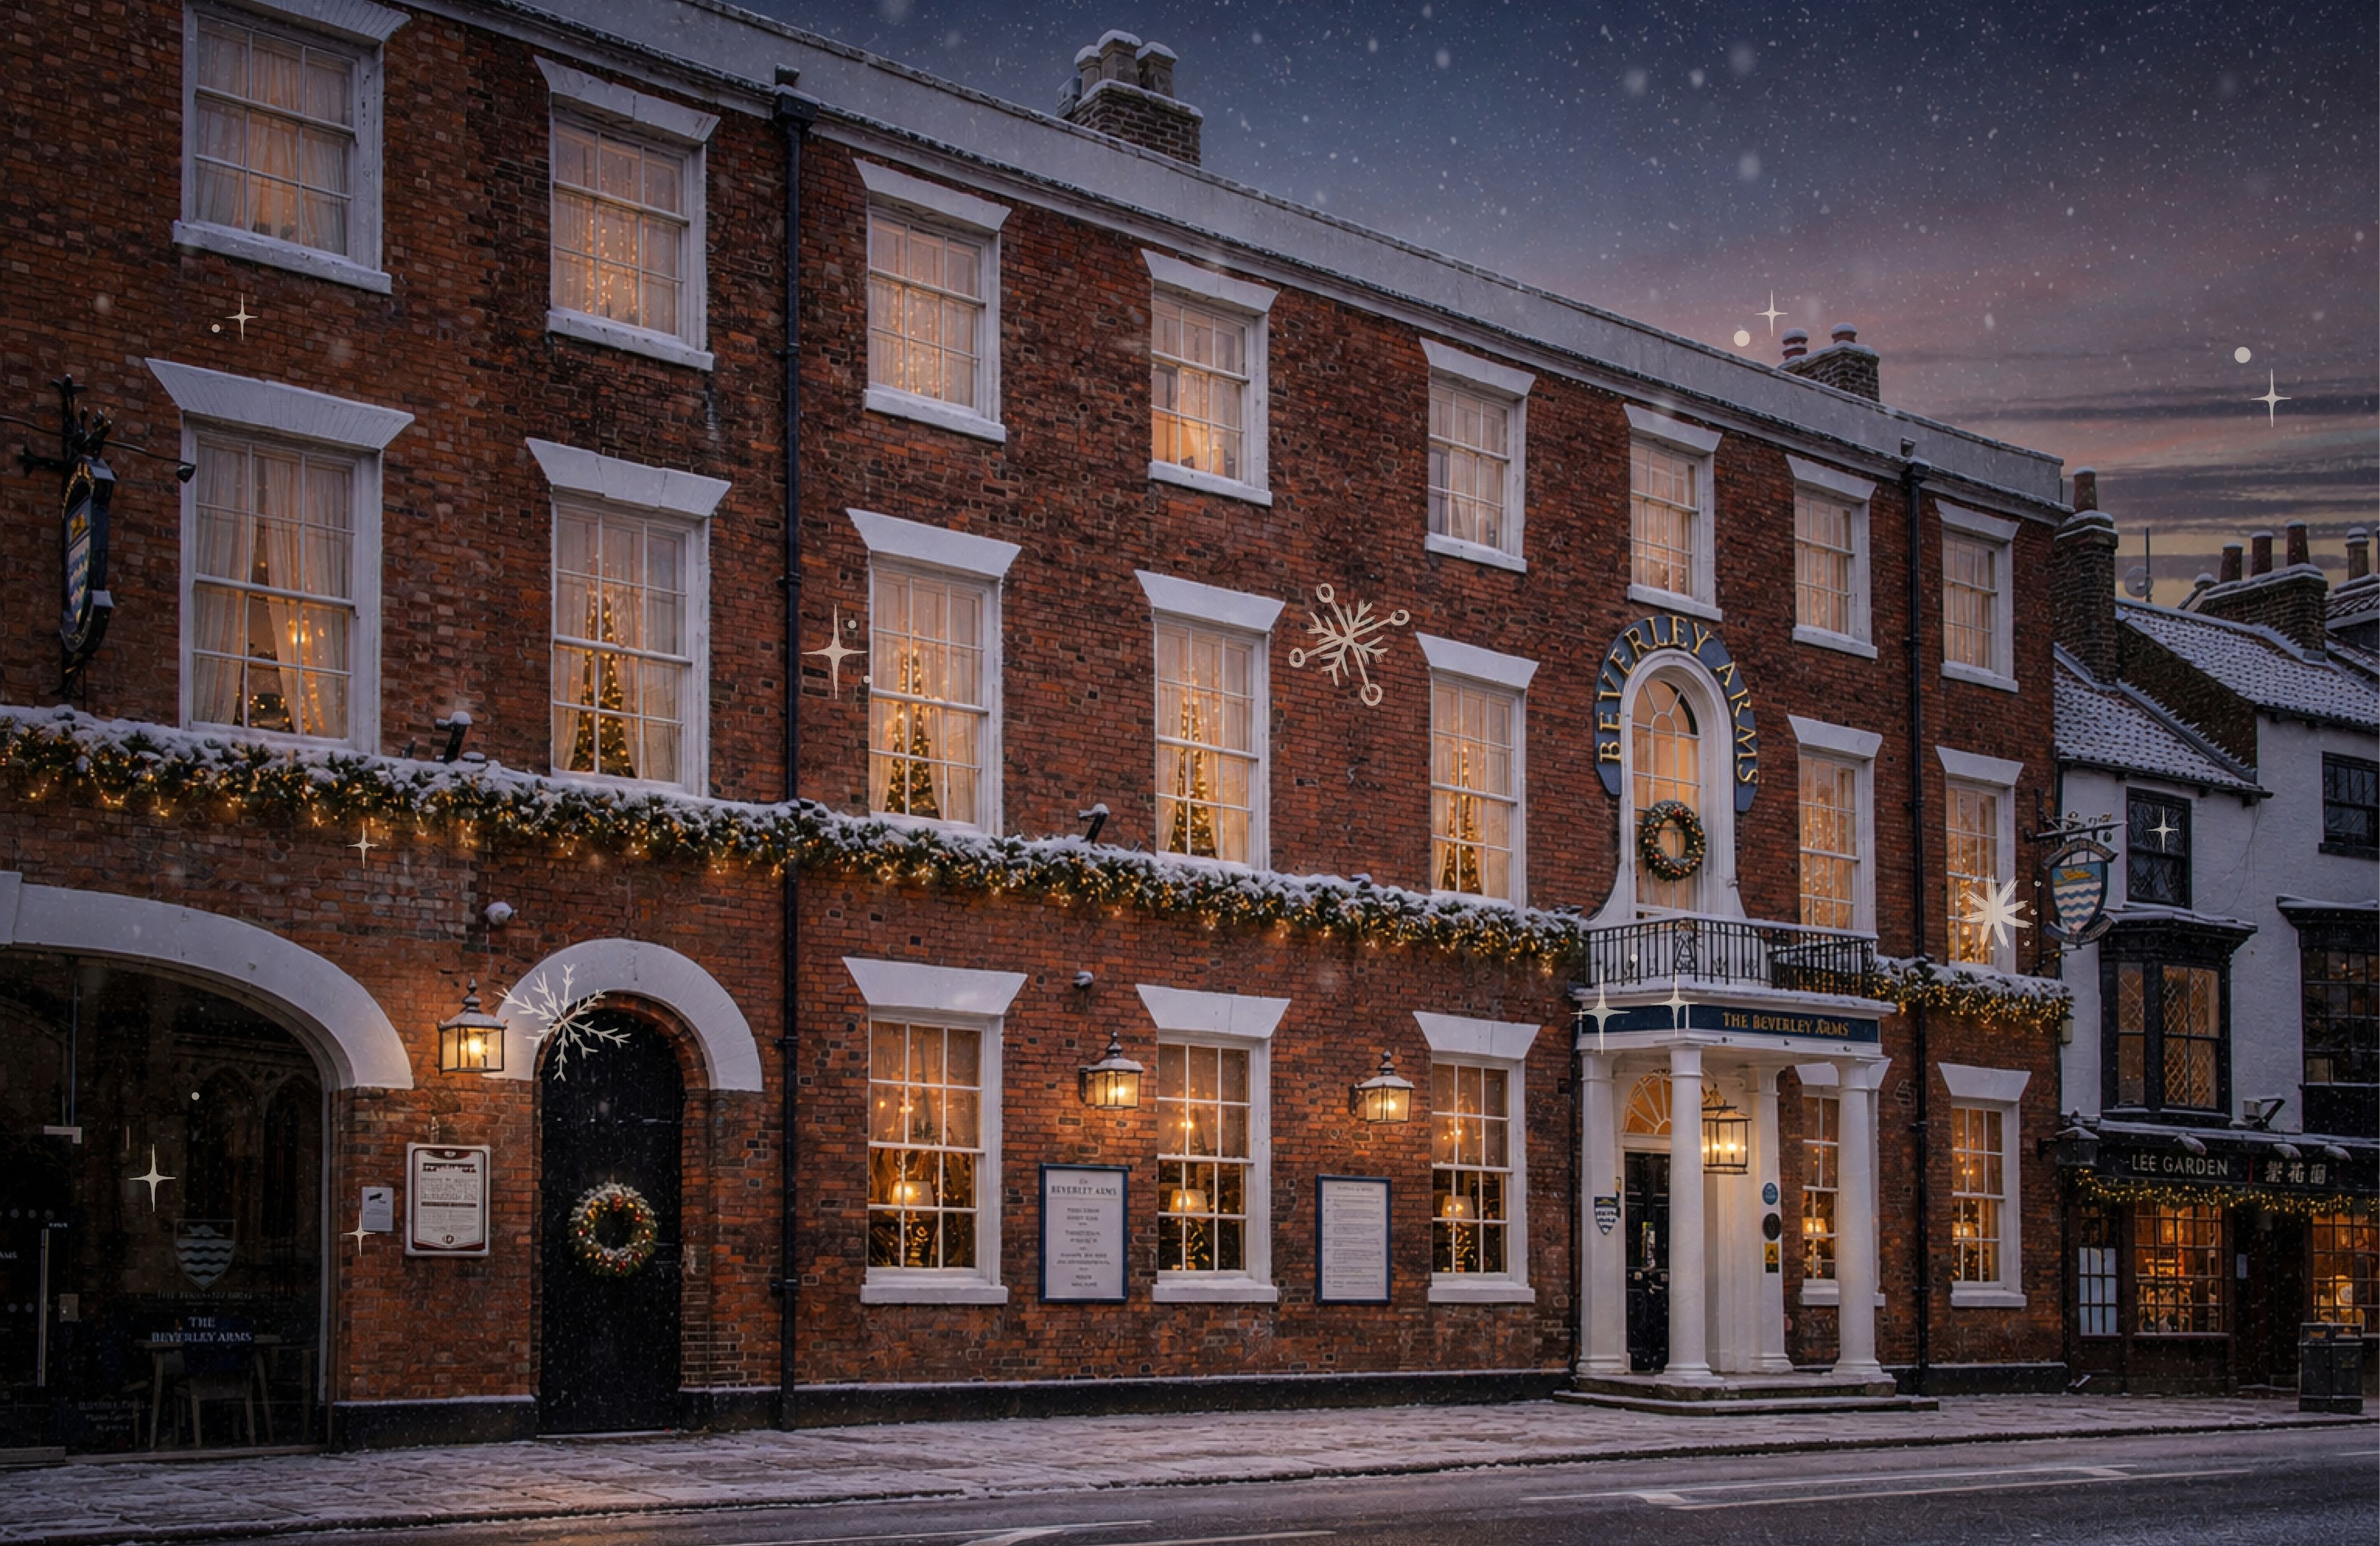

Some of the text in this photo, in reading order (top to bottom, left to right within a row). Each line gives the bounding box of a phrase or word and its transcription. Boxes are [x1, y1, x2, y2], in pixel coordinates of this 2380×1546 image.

[1598, 615, 1759, 784] BEVERLEY ARMS
[1722, 1011, 1850, 1038] THE BEVERLEY ARMS
[2132, 1154, 2228, 1175] LEE GARDEN
[188, 1316, 216, 1328] THE
[151, 1332, 253, 1343] BEVERLEY ARMS
